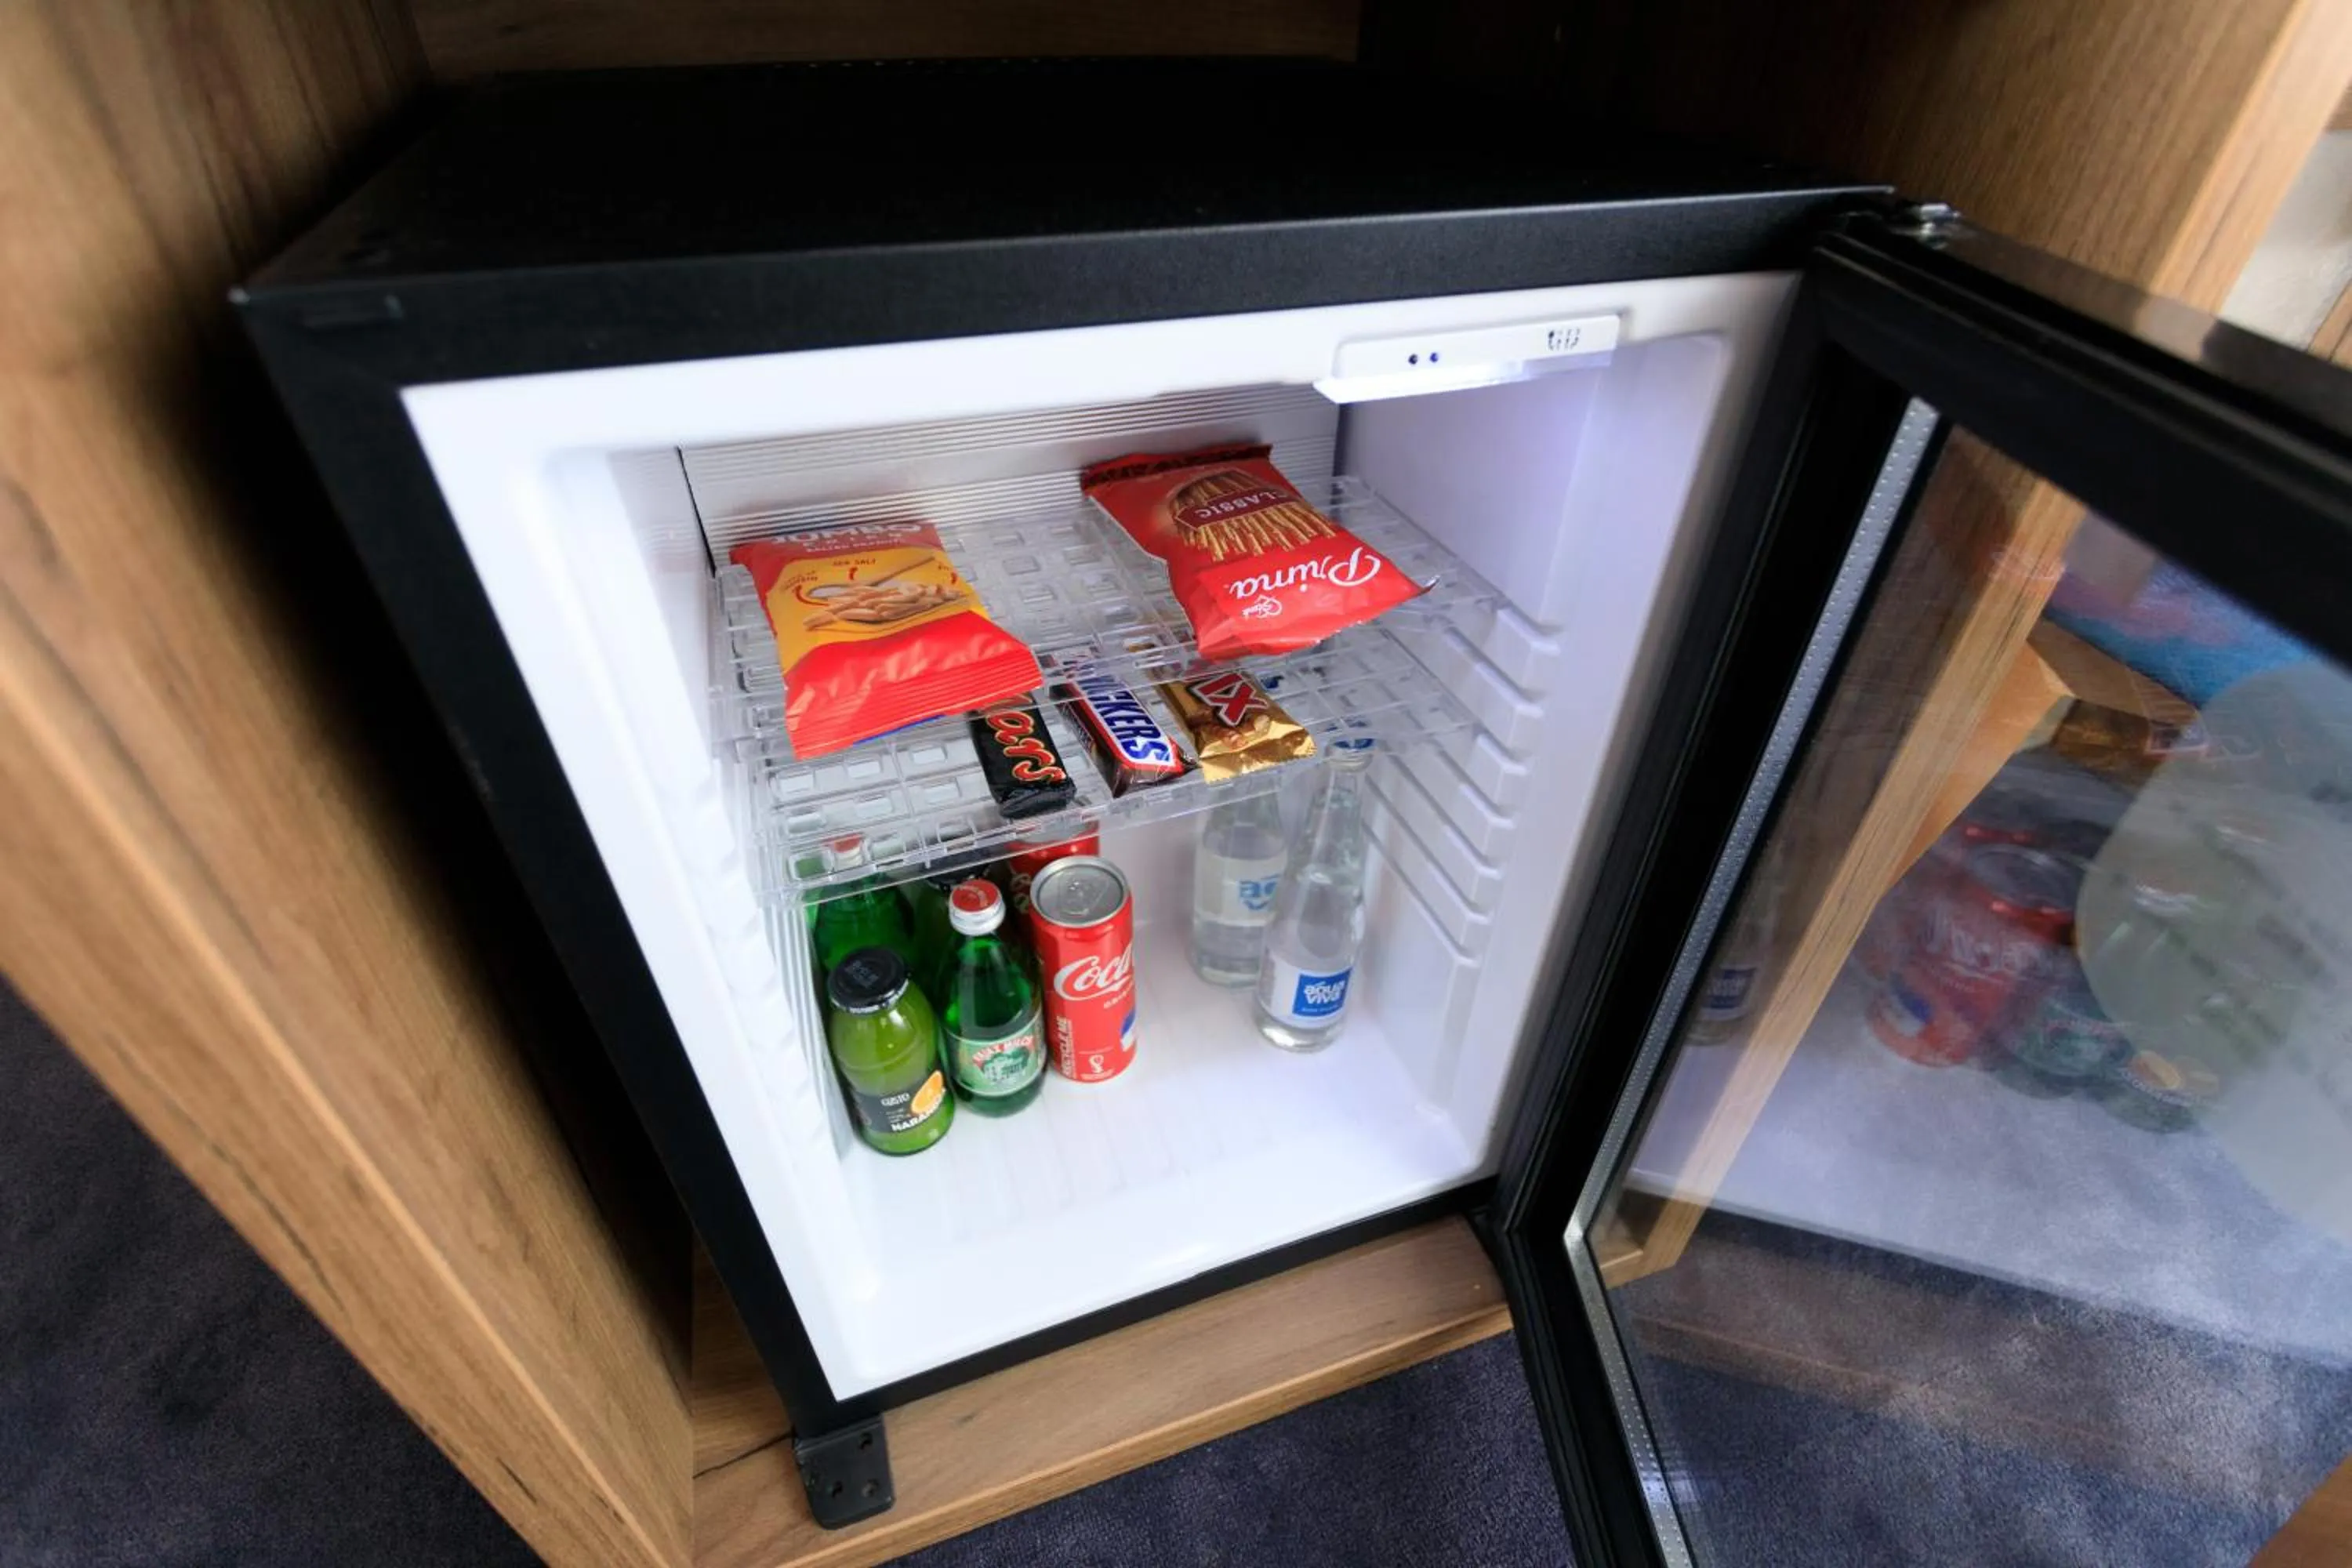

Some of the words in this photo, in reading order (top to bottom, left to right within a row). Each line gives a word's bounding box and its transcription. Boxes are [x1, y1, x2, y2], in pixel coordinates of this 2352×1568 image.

[1229, 546, 1381, 599] Prima
[1186, 668, 1268, 727] IX
[985, 697, 1067, 782] ars
